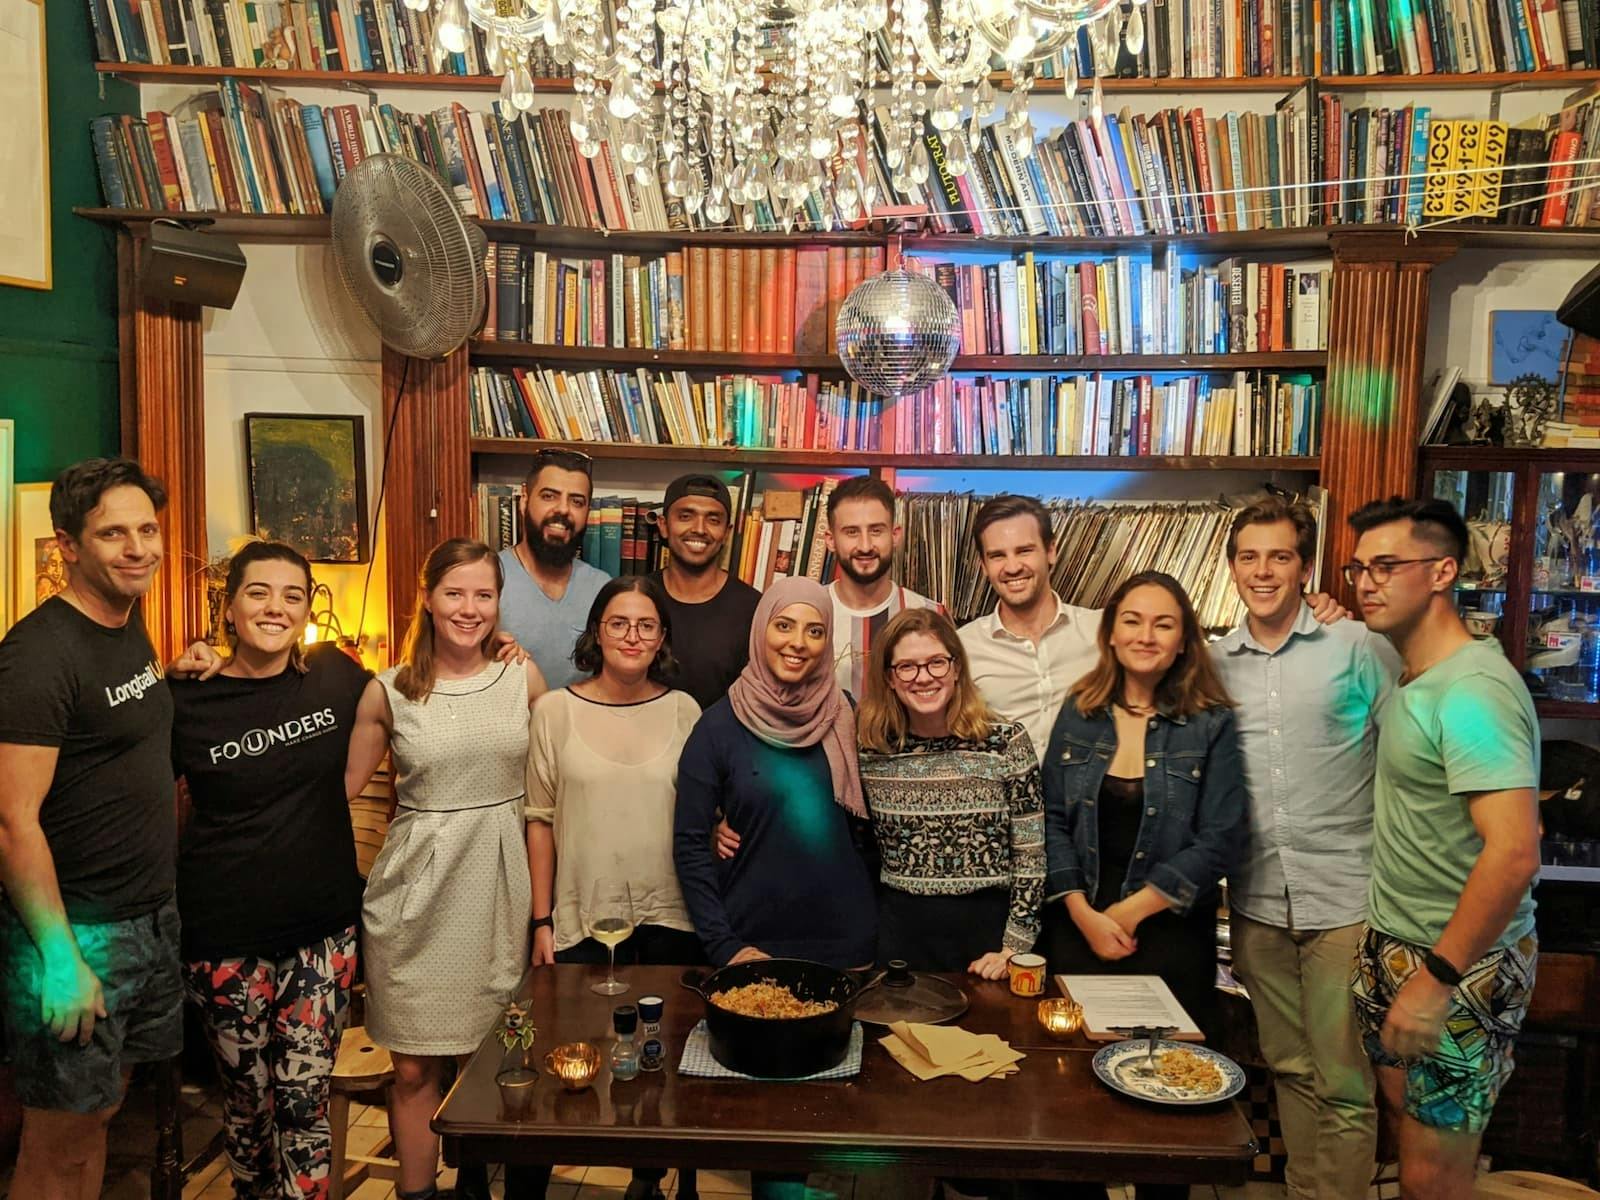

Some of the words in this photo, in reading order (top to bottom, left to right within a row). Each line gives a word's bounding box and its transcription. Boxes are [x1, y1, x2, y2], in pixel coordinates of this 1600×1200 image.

[345, 114, 355, 140] WORLD
[1194, 115, 1202, 125] Art
[1196, 132, 1204, 142] the
[1141, 143, 1153, 168] WORLD
[1198, 141, 1207, 164] October
[927, 135, 960, 205] PLUTOCRAT
[1003, 134, 1025, 181] MODERN
[1019, 181, 1031, 202] ART
[1231, 267, 1242, 306] DESERTER
[209, 707, 336, 765] FOUNDERS
